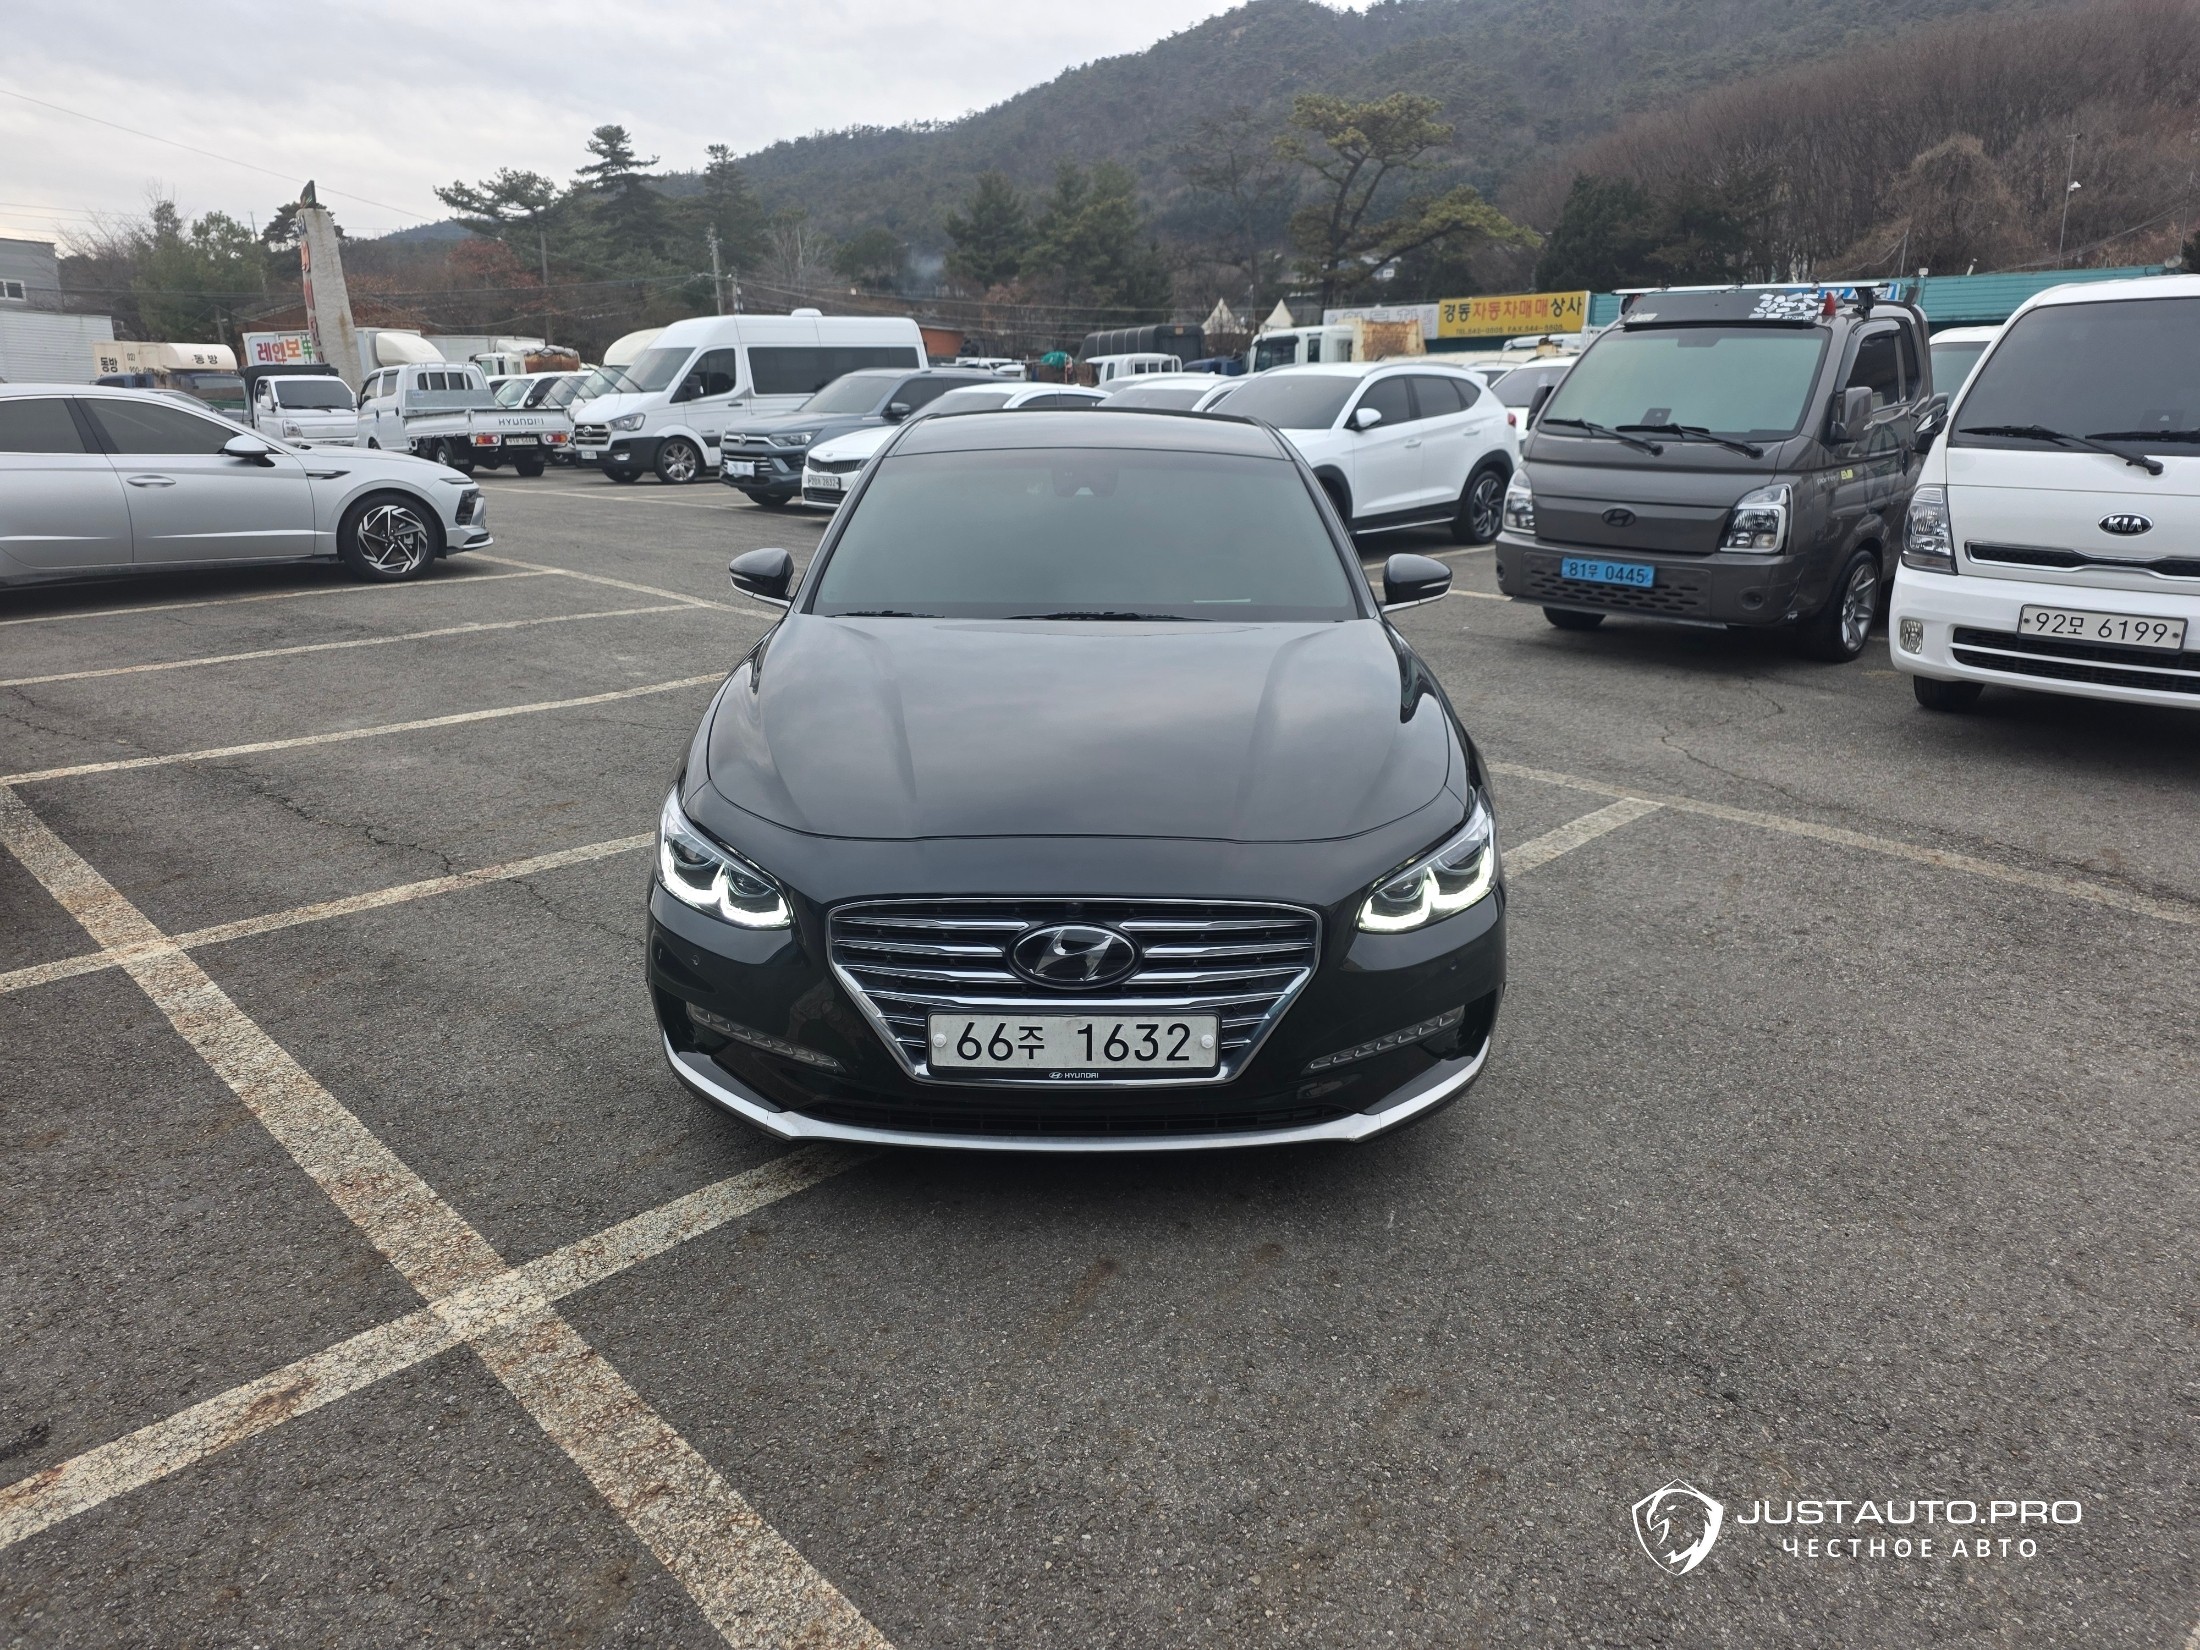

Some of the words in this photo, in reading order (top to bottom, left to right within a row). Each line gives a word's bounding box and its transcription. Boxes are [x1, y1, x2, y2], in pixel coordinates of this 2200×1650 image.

[100, 356, 118, 373] 동방
[2107, 517, 2143, 532] KIA
[1569, 562, 1598, 578] 81무
[1605, 565, 1645, 583] 0445
[2035, 612, 2085, 635] 92모
[2097, 618, 2168, 643] 6199
[956, 1021, 1045, 1061] 66주
[1077, 1023, 1191, 1062] 1632
